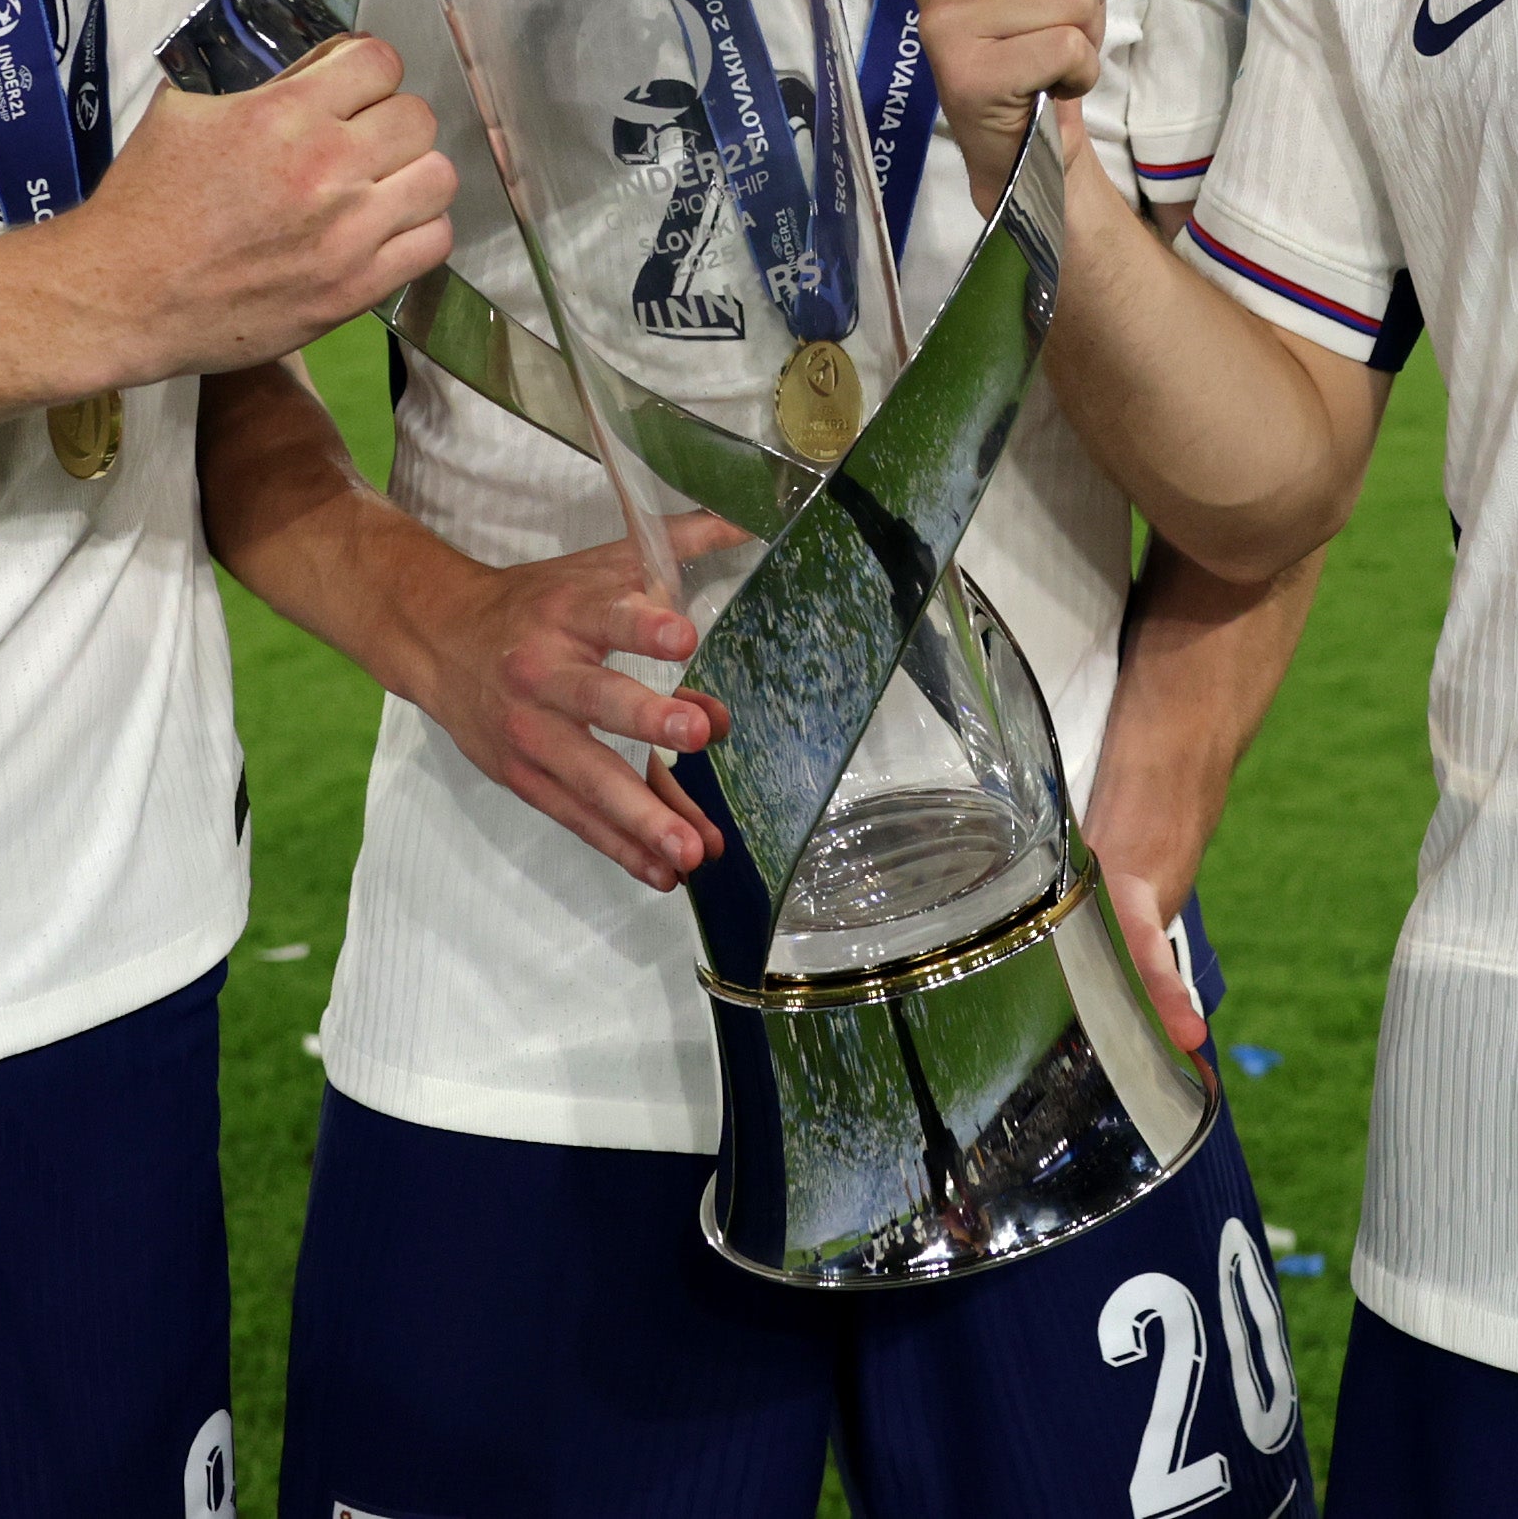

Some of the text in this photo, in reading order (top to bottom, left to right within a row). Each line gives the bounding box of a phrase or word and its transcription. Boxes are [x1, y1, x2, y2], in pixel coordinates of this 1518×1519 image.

[717, 36, 770, 152] SLOVAKIA
[873, 9, 921, 205] SLOVAKIA 202
[609, 139, 765, 198] NDER21
[831, 153, 847, 216] 2025
[638, 211, 757, 257] SLOVAKIA
[671, 245, 737, 279] 2025
[633, 251, 823, 333] INNRS
[1097, 1217, 1298, 1519] 20
